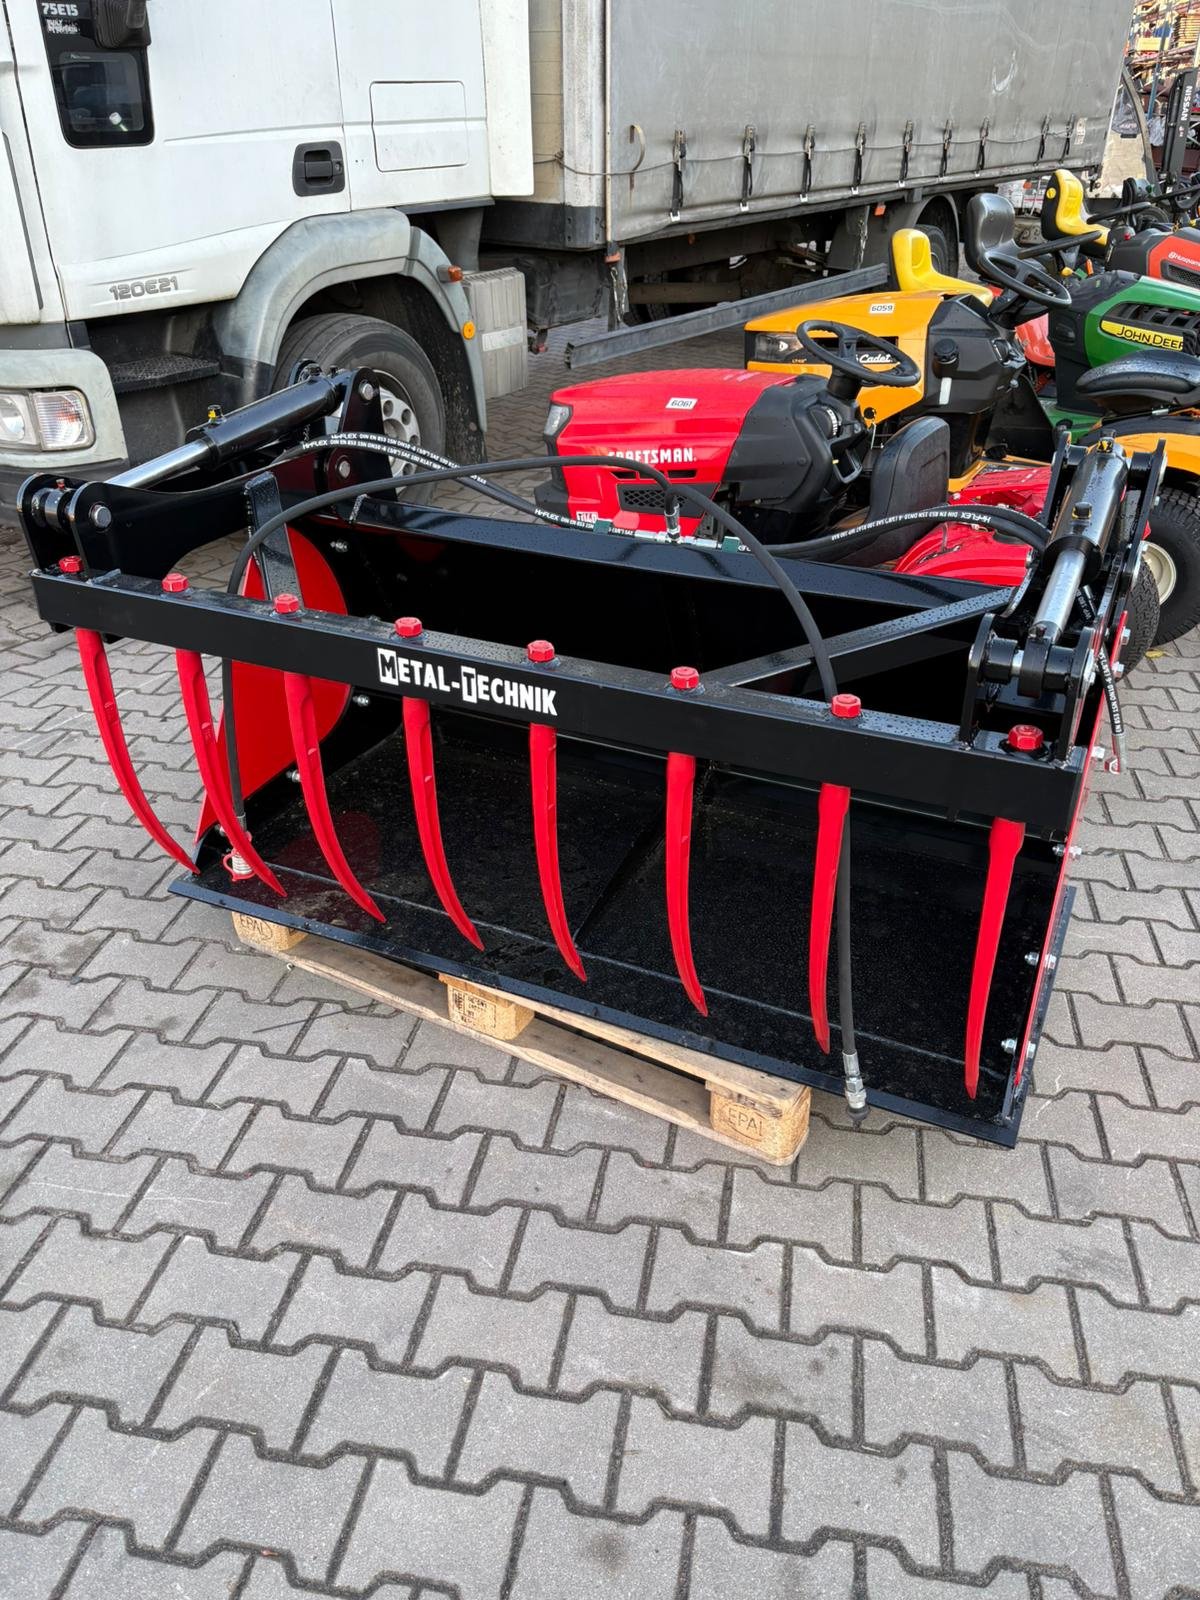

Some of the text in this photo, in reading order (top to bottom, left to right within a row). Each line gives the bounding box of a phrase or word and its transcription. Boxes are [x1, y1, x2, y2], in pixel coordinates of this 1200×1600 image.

[42, 2, 79, 17] 75E15
[1180, 85, 1193, 120] NISSAN
[109, 276, 178, 300] 120E21
[871, 304, 893, 312] 6059
[1116, 326, 1151, 342] JOHN
[860, 354, 892, 363] Cadet
[670, 400, 693, 408] 6061
[377, 648, 558, 716] METAL-TECHNIK
